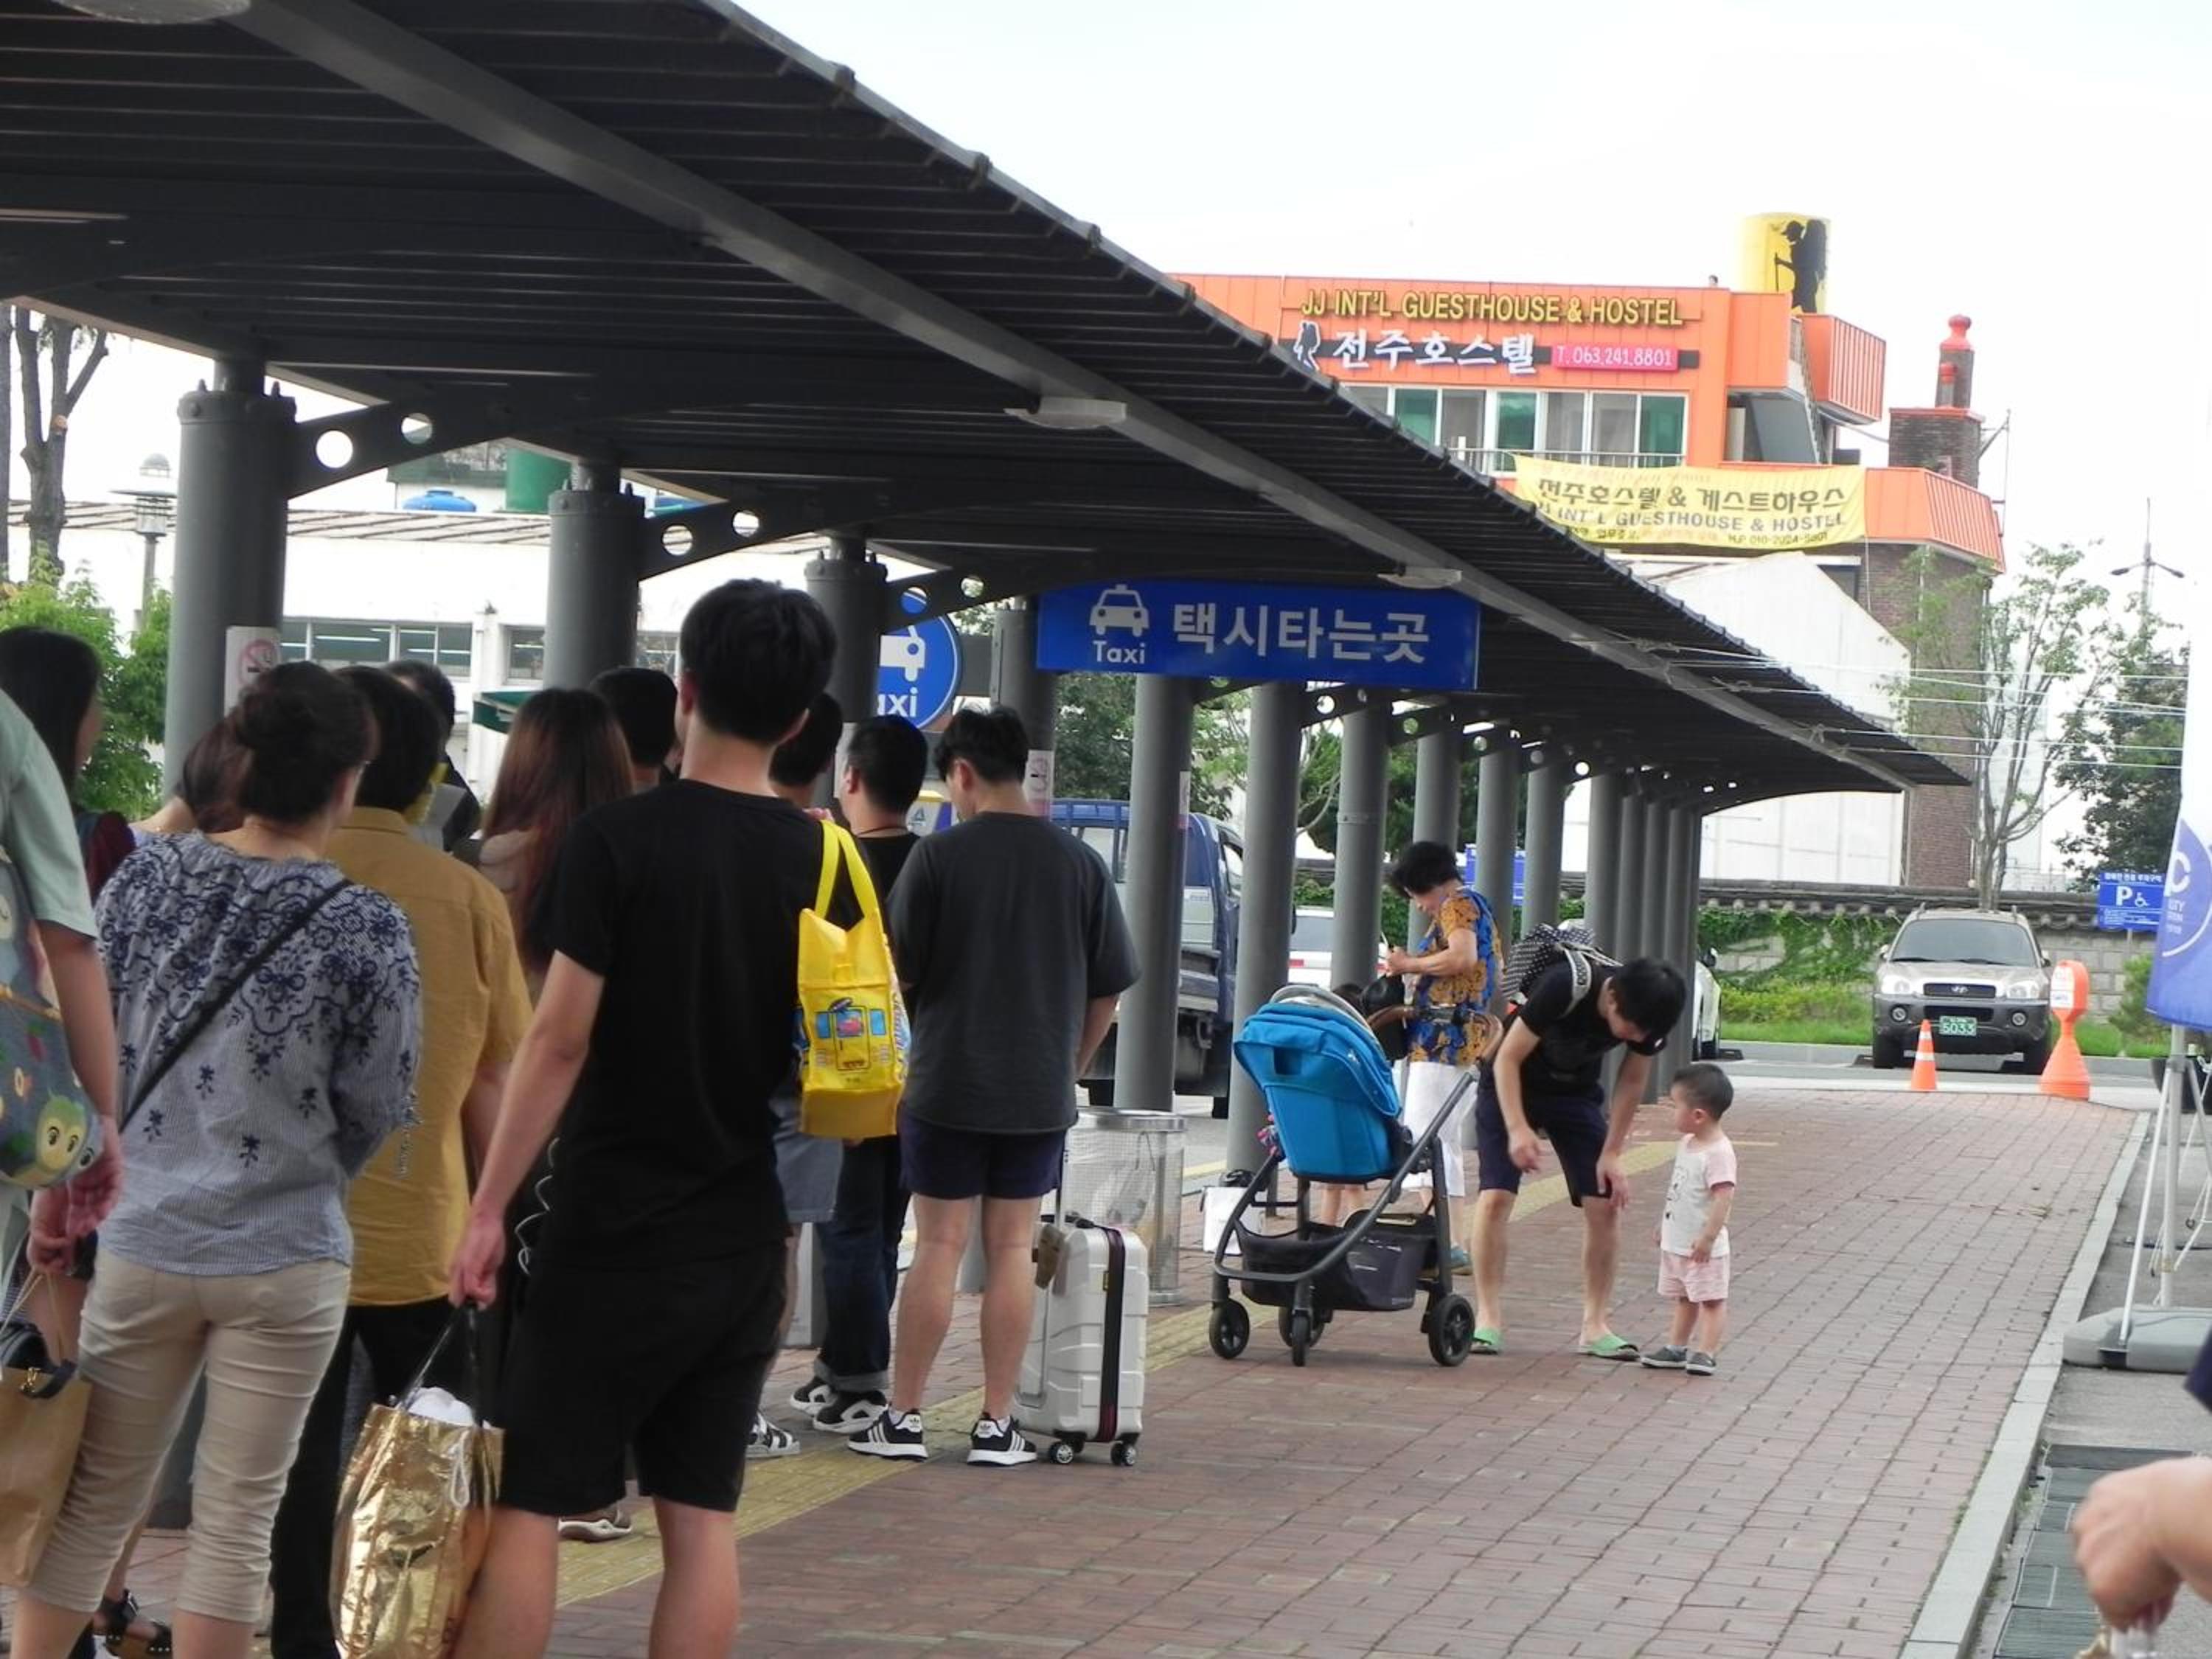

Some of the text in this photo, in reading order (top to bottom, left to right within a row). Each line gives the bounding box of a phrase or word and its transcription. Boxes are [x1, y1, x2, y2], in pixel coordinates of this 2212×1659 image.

[1301, 290, 1683, 325] JJ INT'L GUESTHOUSE & HOSTEL
[1332, 329, 1537, 375] 전주호스텔
[1667, 486, 1687, 508] &
[1697, 487, 1845, 514] 게스트하우스
[1615, 511, 1743, 531] GUESTHOUSE
[1750, 518, 1764, 532] &
[1172, 601, 1430, 664] 택시타는곳
[1092, 639, 1147, 665] Taxi
[2115, 886, 2133, 906] P
